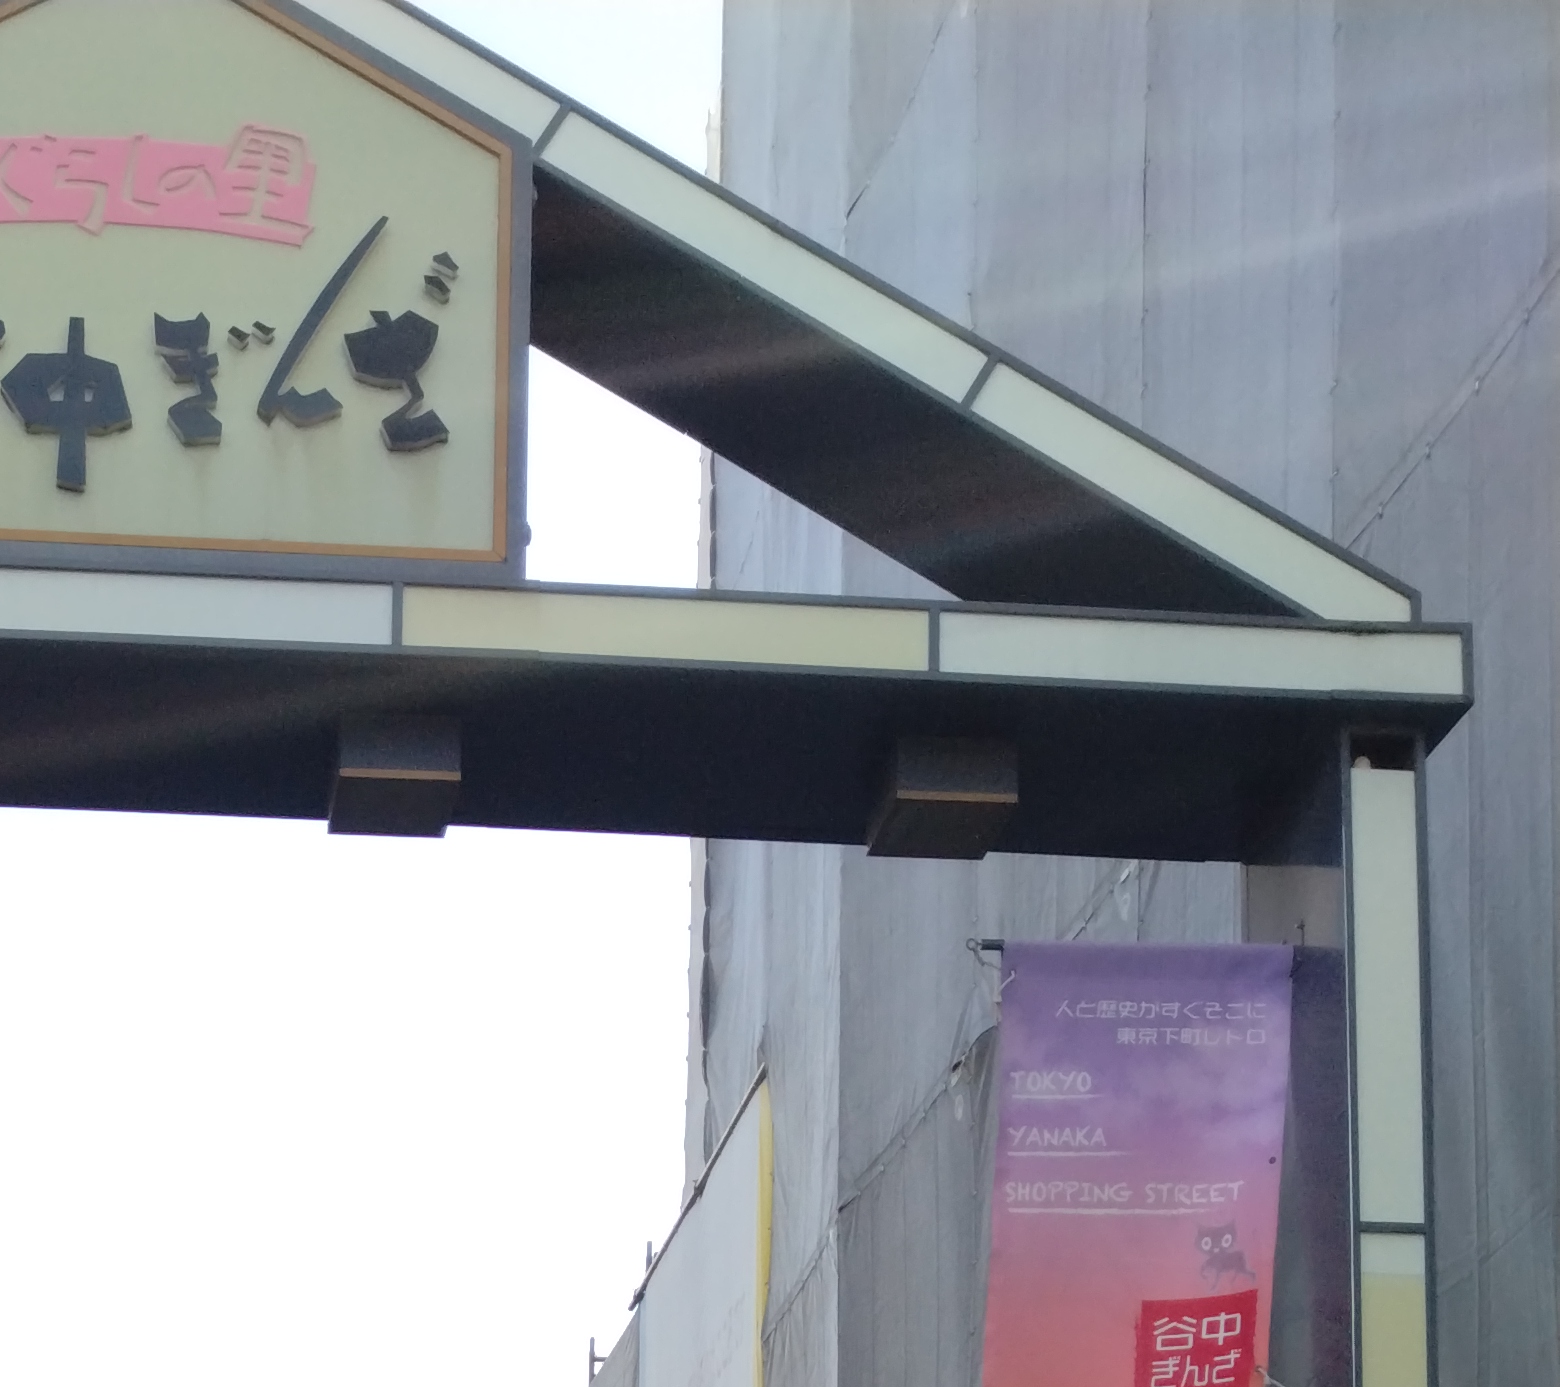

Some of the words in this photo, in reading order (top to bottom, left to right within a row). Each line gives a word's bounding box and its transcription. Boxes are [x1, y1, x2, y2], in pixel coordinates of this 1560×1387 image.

[1055, 999, 1267, 1020] 人と歴史がすぐそこに
[1116, 1027, 1267, 1046] 東京下町レトロ
[1011, 1070, 1092, 1093] TOKYO
[1007, 1124, 1107, 1148] YANAKA
[1005, 1180, 1131, 1204] SHOPPING
[1144, 1180, 1244, 1204] STREET
[1154, 1311, 1242, 1352] 谷中
